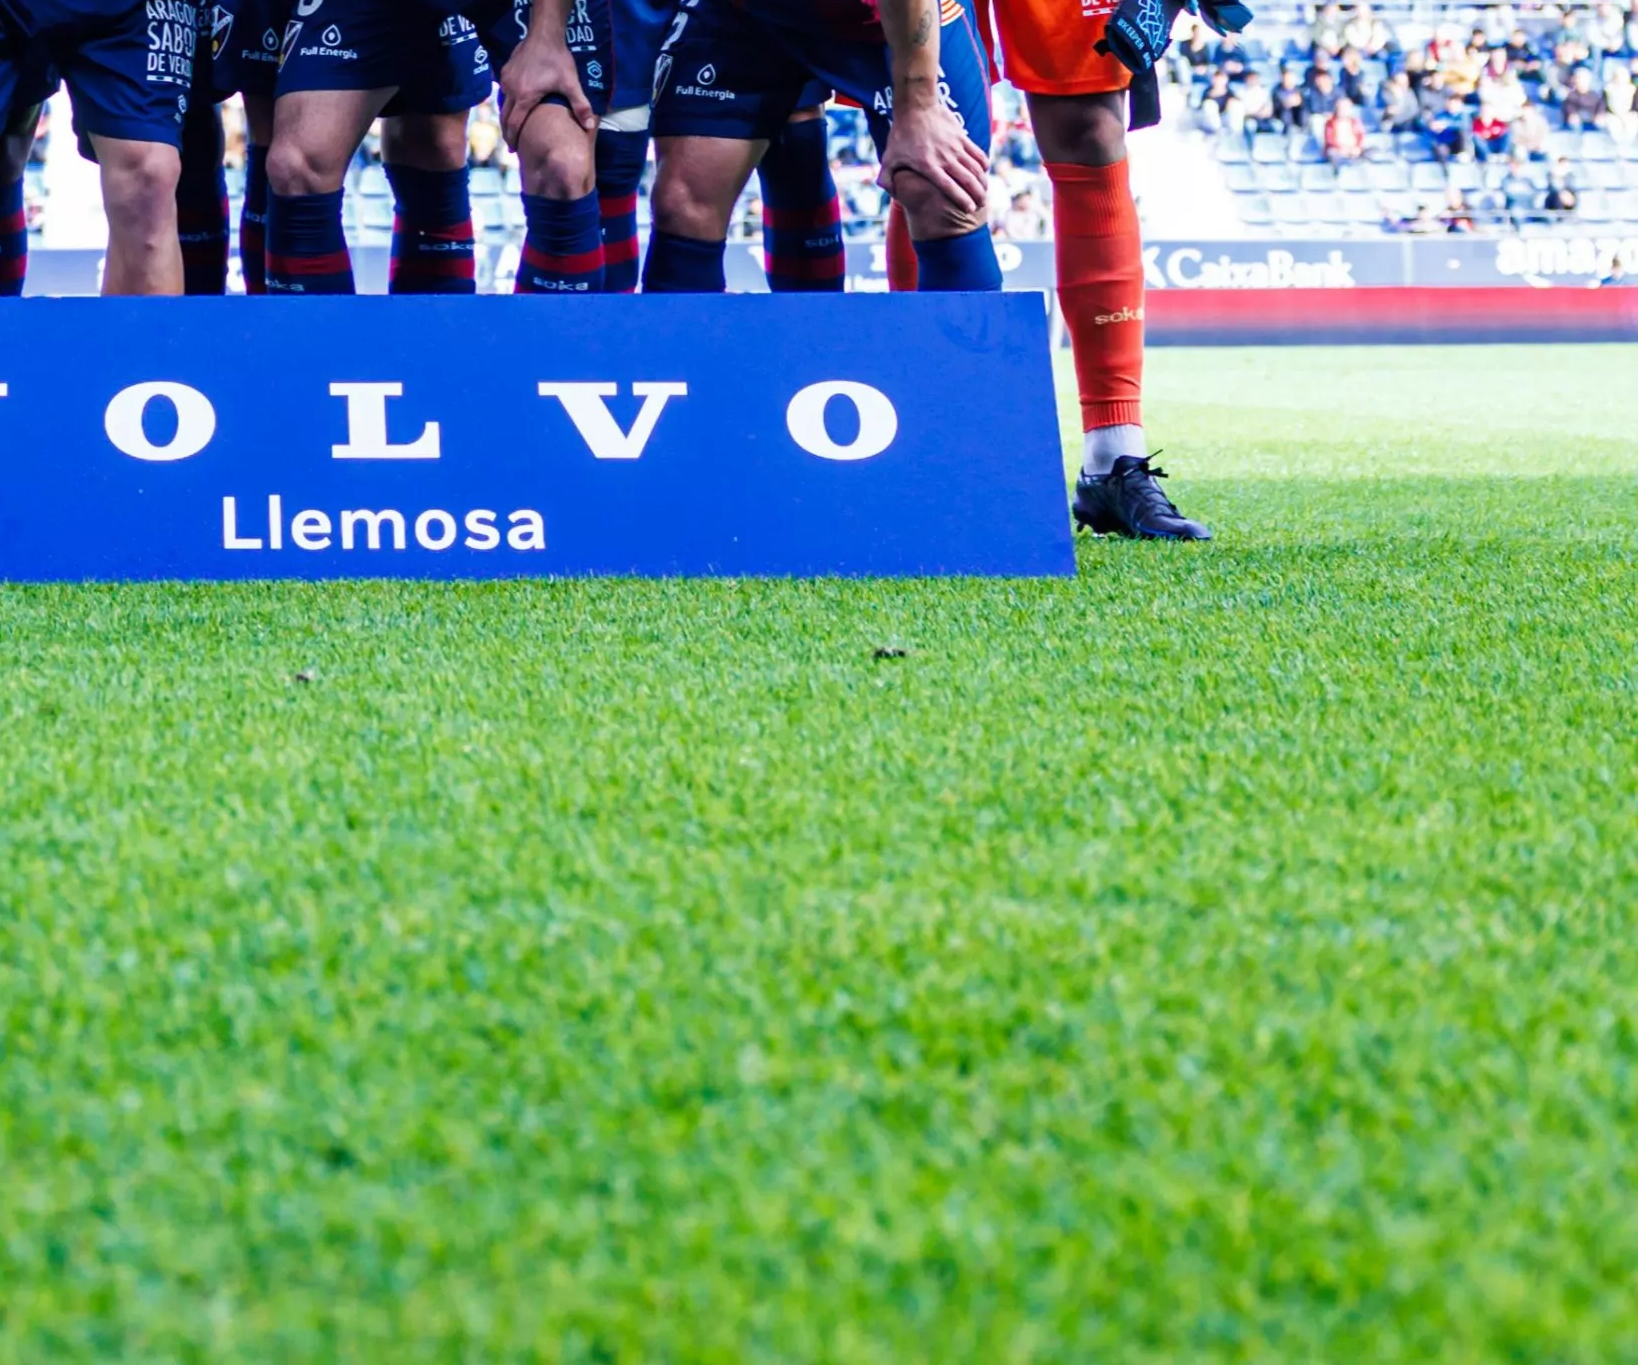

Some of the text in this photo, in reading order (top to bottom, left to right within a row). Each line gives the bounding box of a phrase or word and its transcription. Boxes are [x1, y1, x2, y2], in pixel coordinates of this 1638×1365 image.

[147, 51, 166, 72] DE
[300, 47, 318, 57] Full
[675, 85, 694, 95] Full
[1167, 249, 1357, 289] CaixaBank
[222, 495, 546, 551] Llemosa
